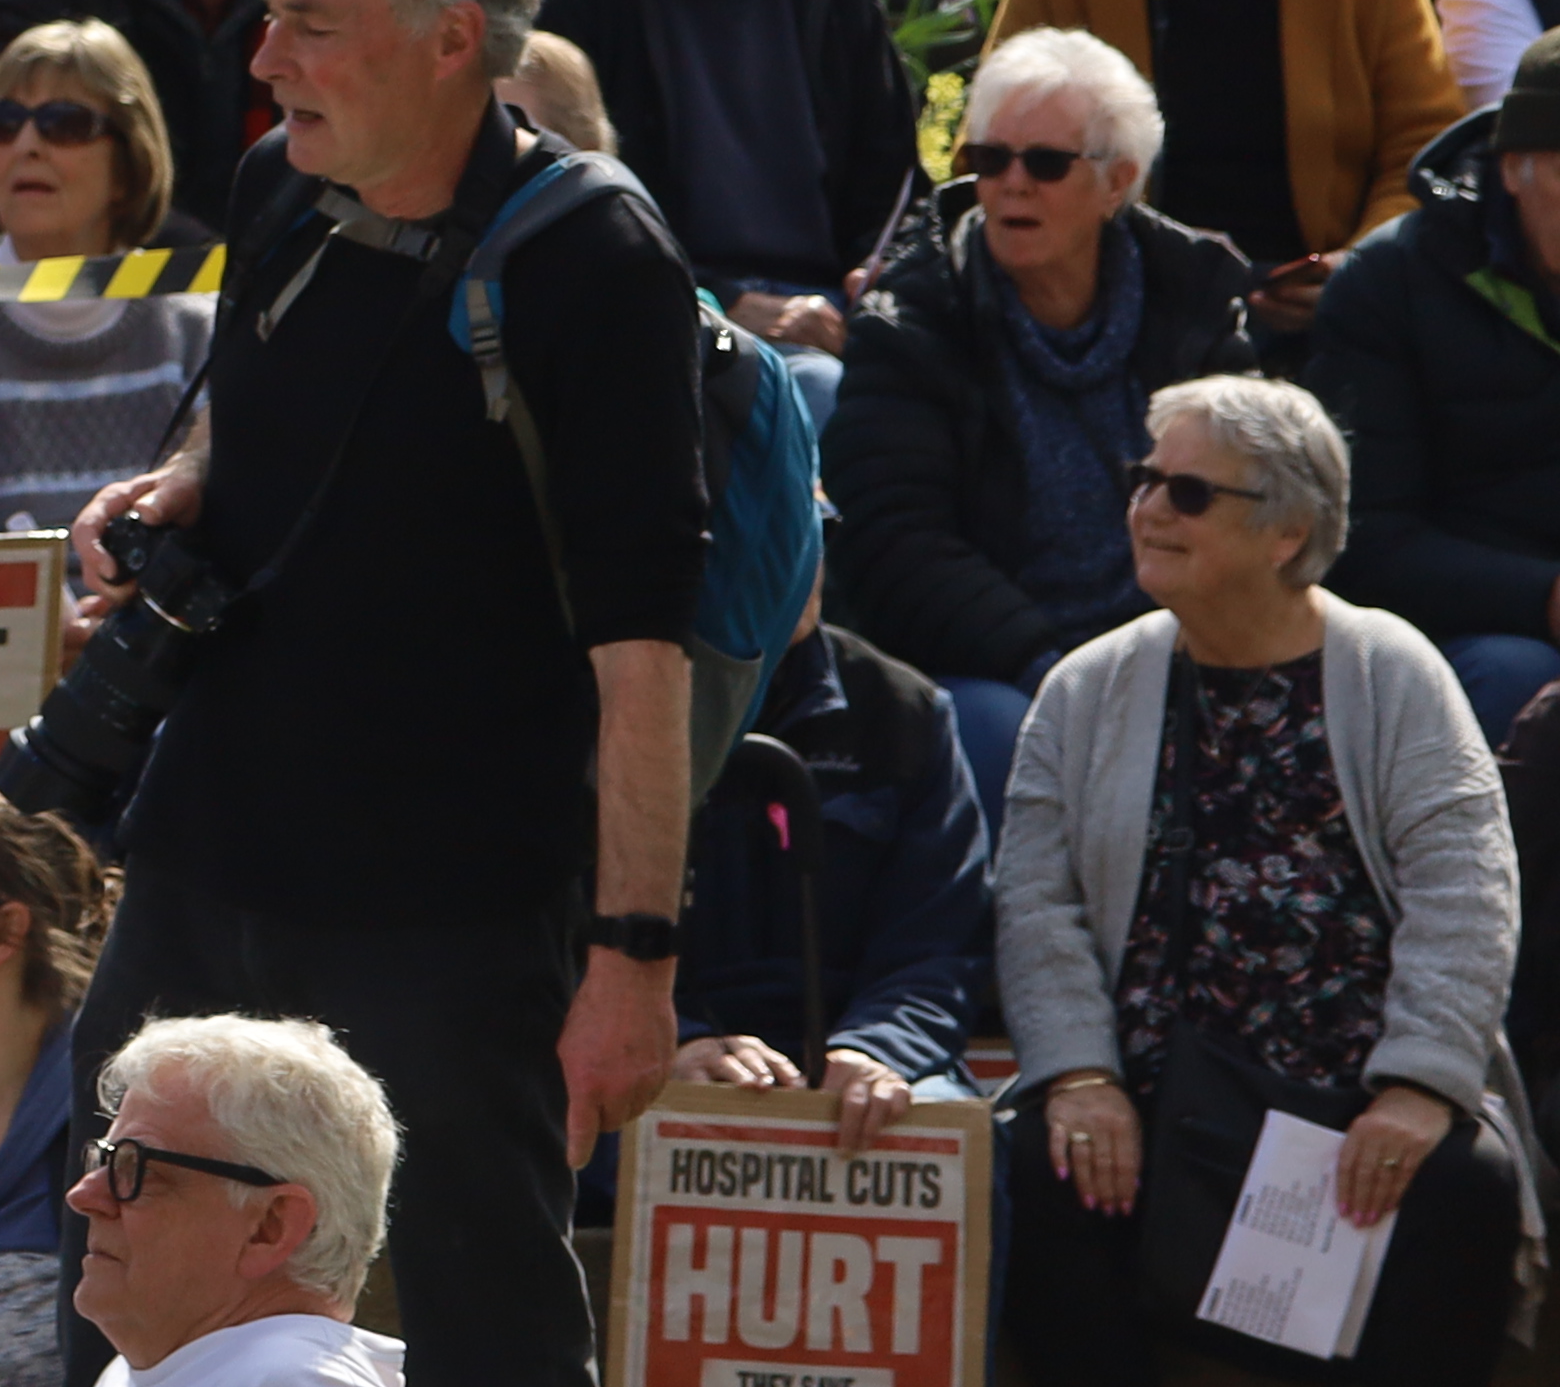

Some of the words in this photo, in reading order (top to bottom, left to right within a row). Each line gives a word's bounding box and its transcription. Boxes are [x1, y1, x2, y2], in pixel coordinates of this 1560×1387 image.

[669, 1148, 836, 1204] HOSPITAL
[846, 1161, 943, 1209] CUTS
[663, 1223, 944, 1356] HURT
